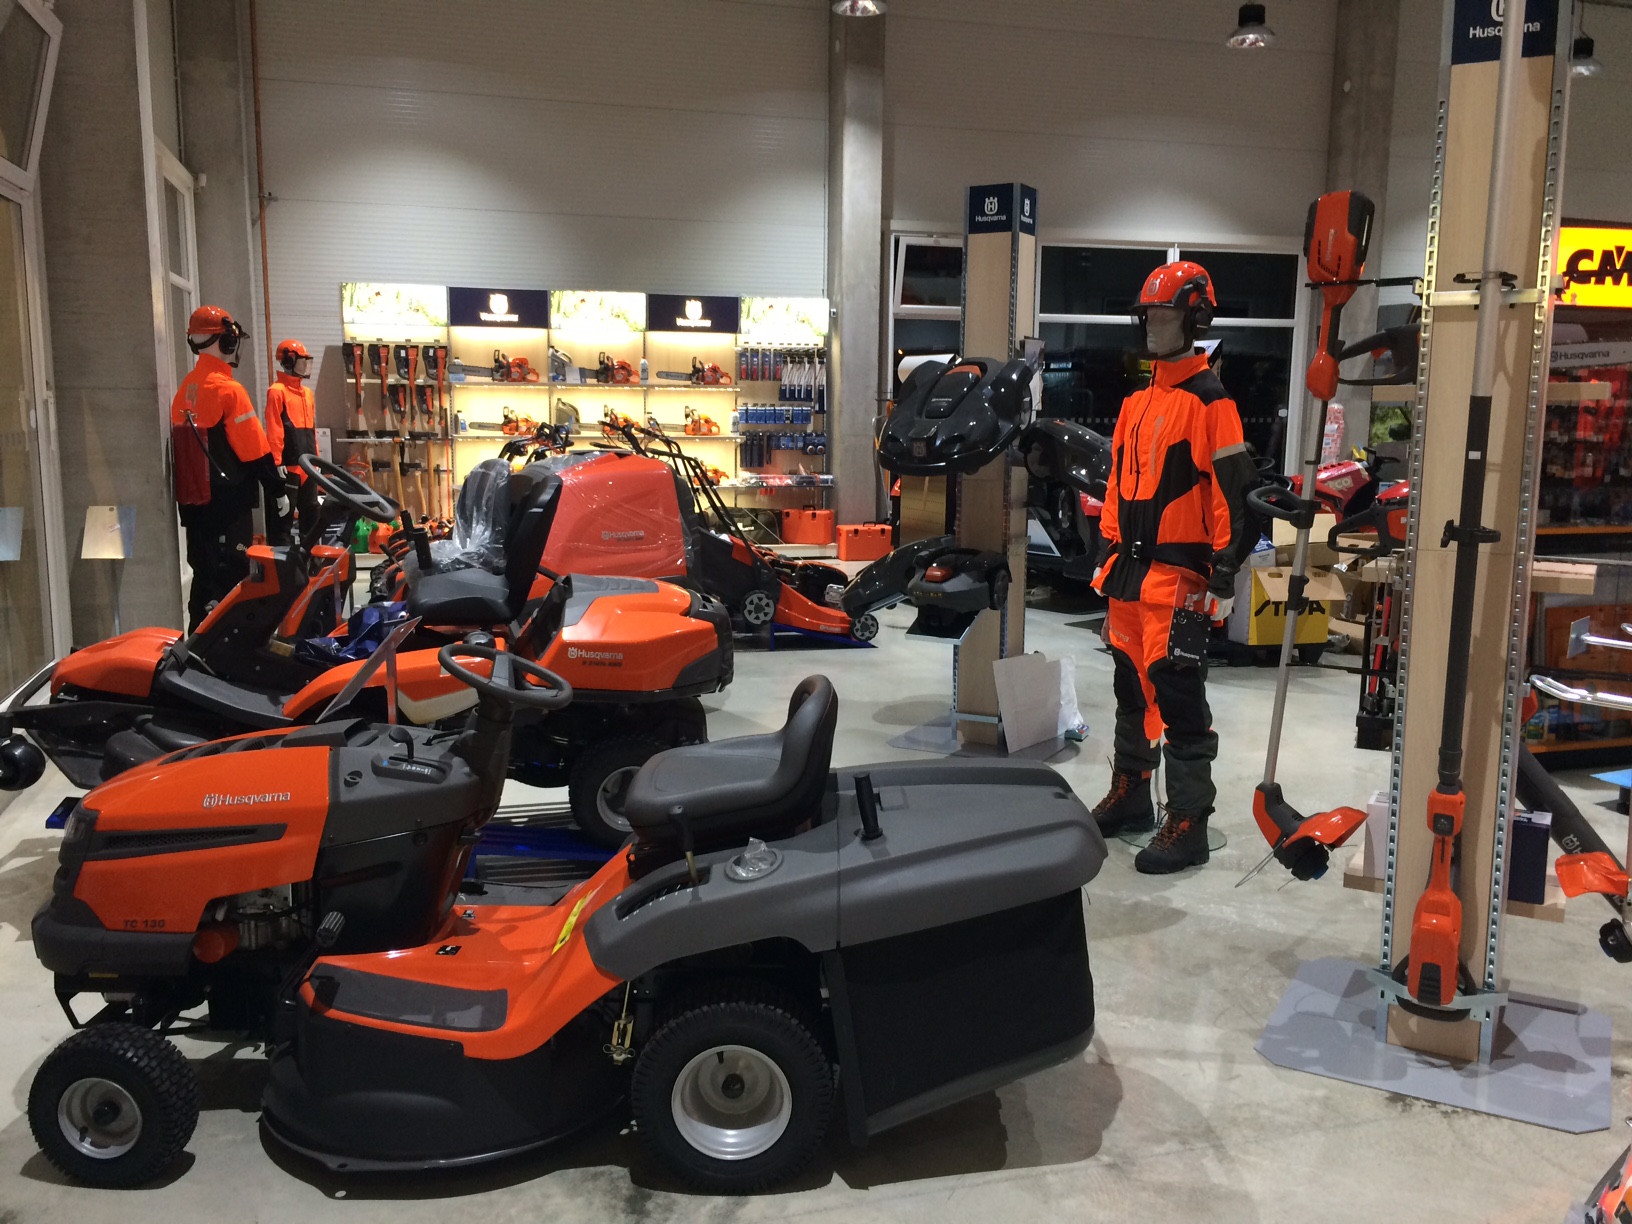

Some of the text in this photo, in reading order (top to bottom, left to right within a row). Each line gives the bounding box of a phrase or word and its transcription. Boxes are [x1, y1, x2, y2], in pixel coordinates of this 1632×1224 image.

[1469, 22, 1541, 39] Husqna
[1559, 350, 1610, 361] Husqvarna
[577, 649, 624, 660] Husqvarna
[218, 791, 291, 806] Husqvarna
[124, 919, 138, 929] TC
